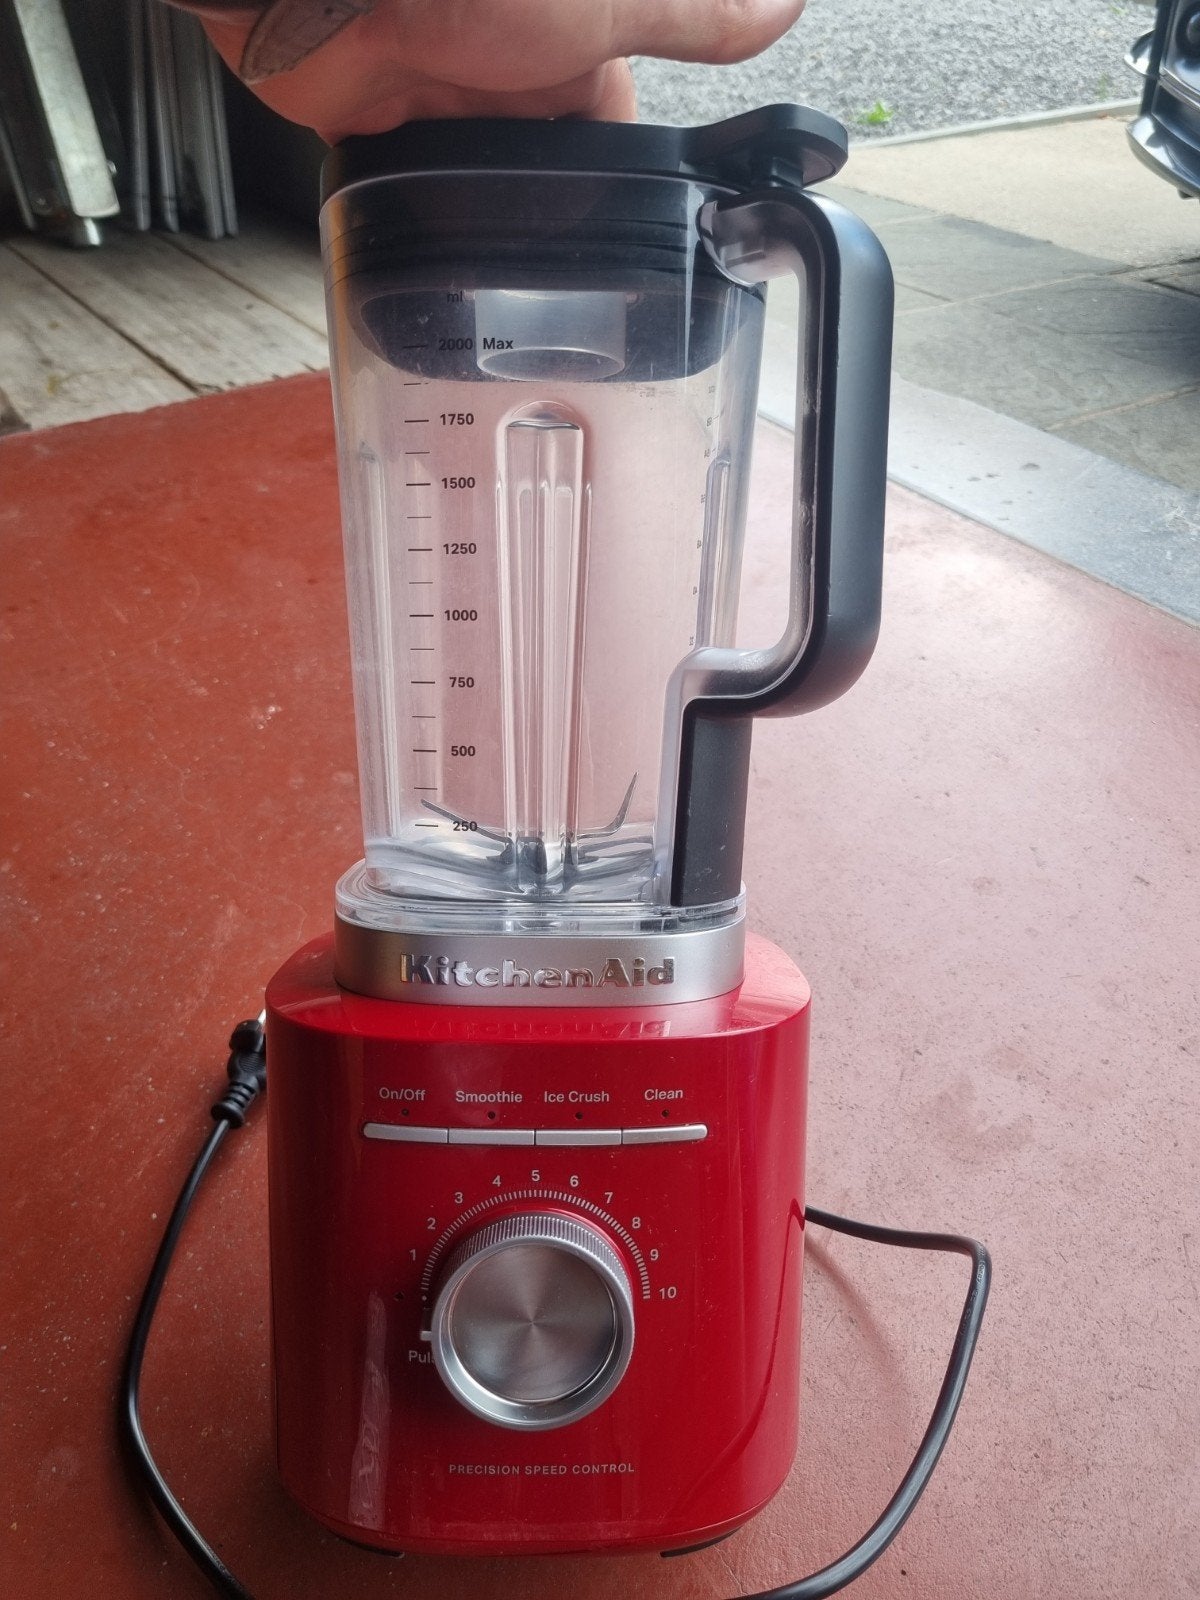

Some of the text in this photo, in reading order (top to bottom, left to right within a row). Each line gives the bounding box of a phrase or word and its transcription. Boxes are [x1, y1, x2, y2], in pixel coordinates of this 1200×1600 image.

[438, 337, 514, 351] 2000 Max
[440, 412, 474, 426] 1750
[441, 476, 475, 490] 1500
[443, 542, 477, 555] 1250
[444, 609, 478, 622] 1000
[449, 676, 475, 689] 750
[451, 745, 475, 758] 500
[453, 820, 478, 832] 250
[400, 953, 675, 988] KitchenAid
[379, 1087, 425, 1101] On/Off
[455, 1090, 522, 1103] Smoothie
[544, 1091, 610, 1103] Ice Crush
[644, 1088, 683, 1101] Clean
[492, 1175, 501, 1187] 4
[531, 1170, 540, 1182] 5
[569, 1175, 579, 1187] 6
[454, 1192, 463, 1204] 3
[605, 1192, 614, 1204] 7
[427, 1218, 437, 1230] 2
[631, 1217, 641, 1229] 8
[409, 1249, 416, 1261] 1
[649, 1249, 659, 1261] 9
[659, 1287, 677, 1299] 10
[408, 1350, 435, 1364] Pul
[449, 1463, 634, 1475] PRECISION SPEED CONTROL
